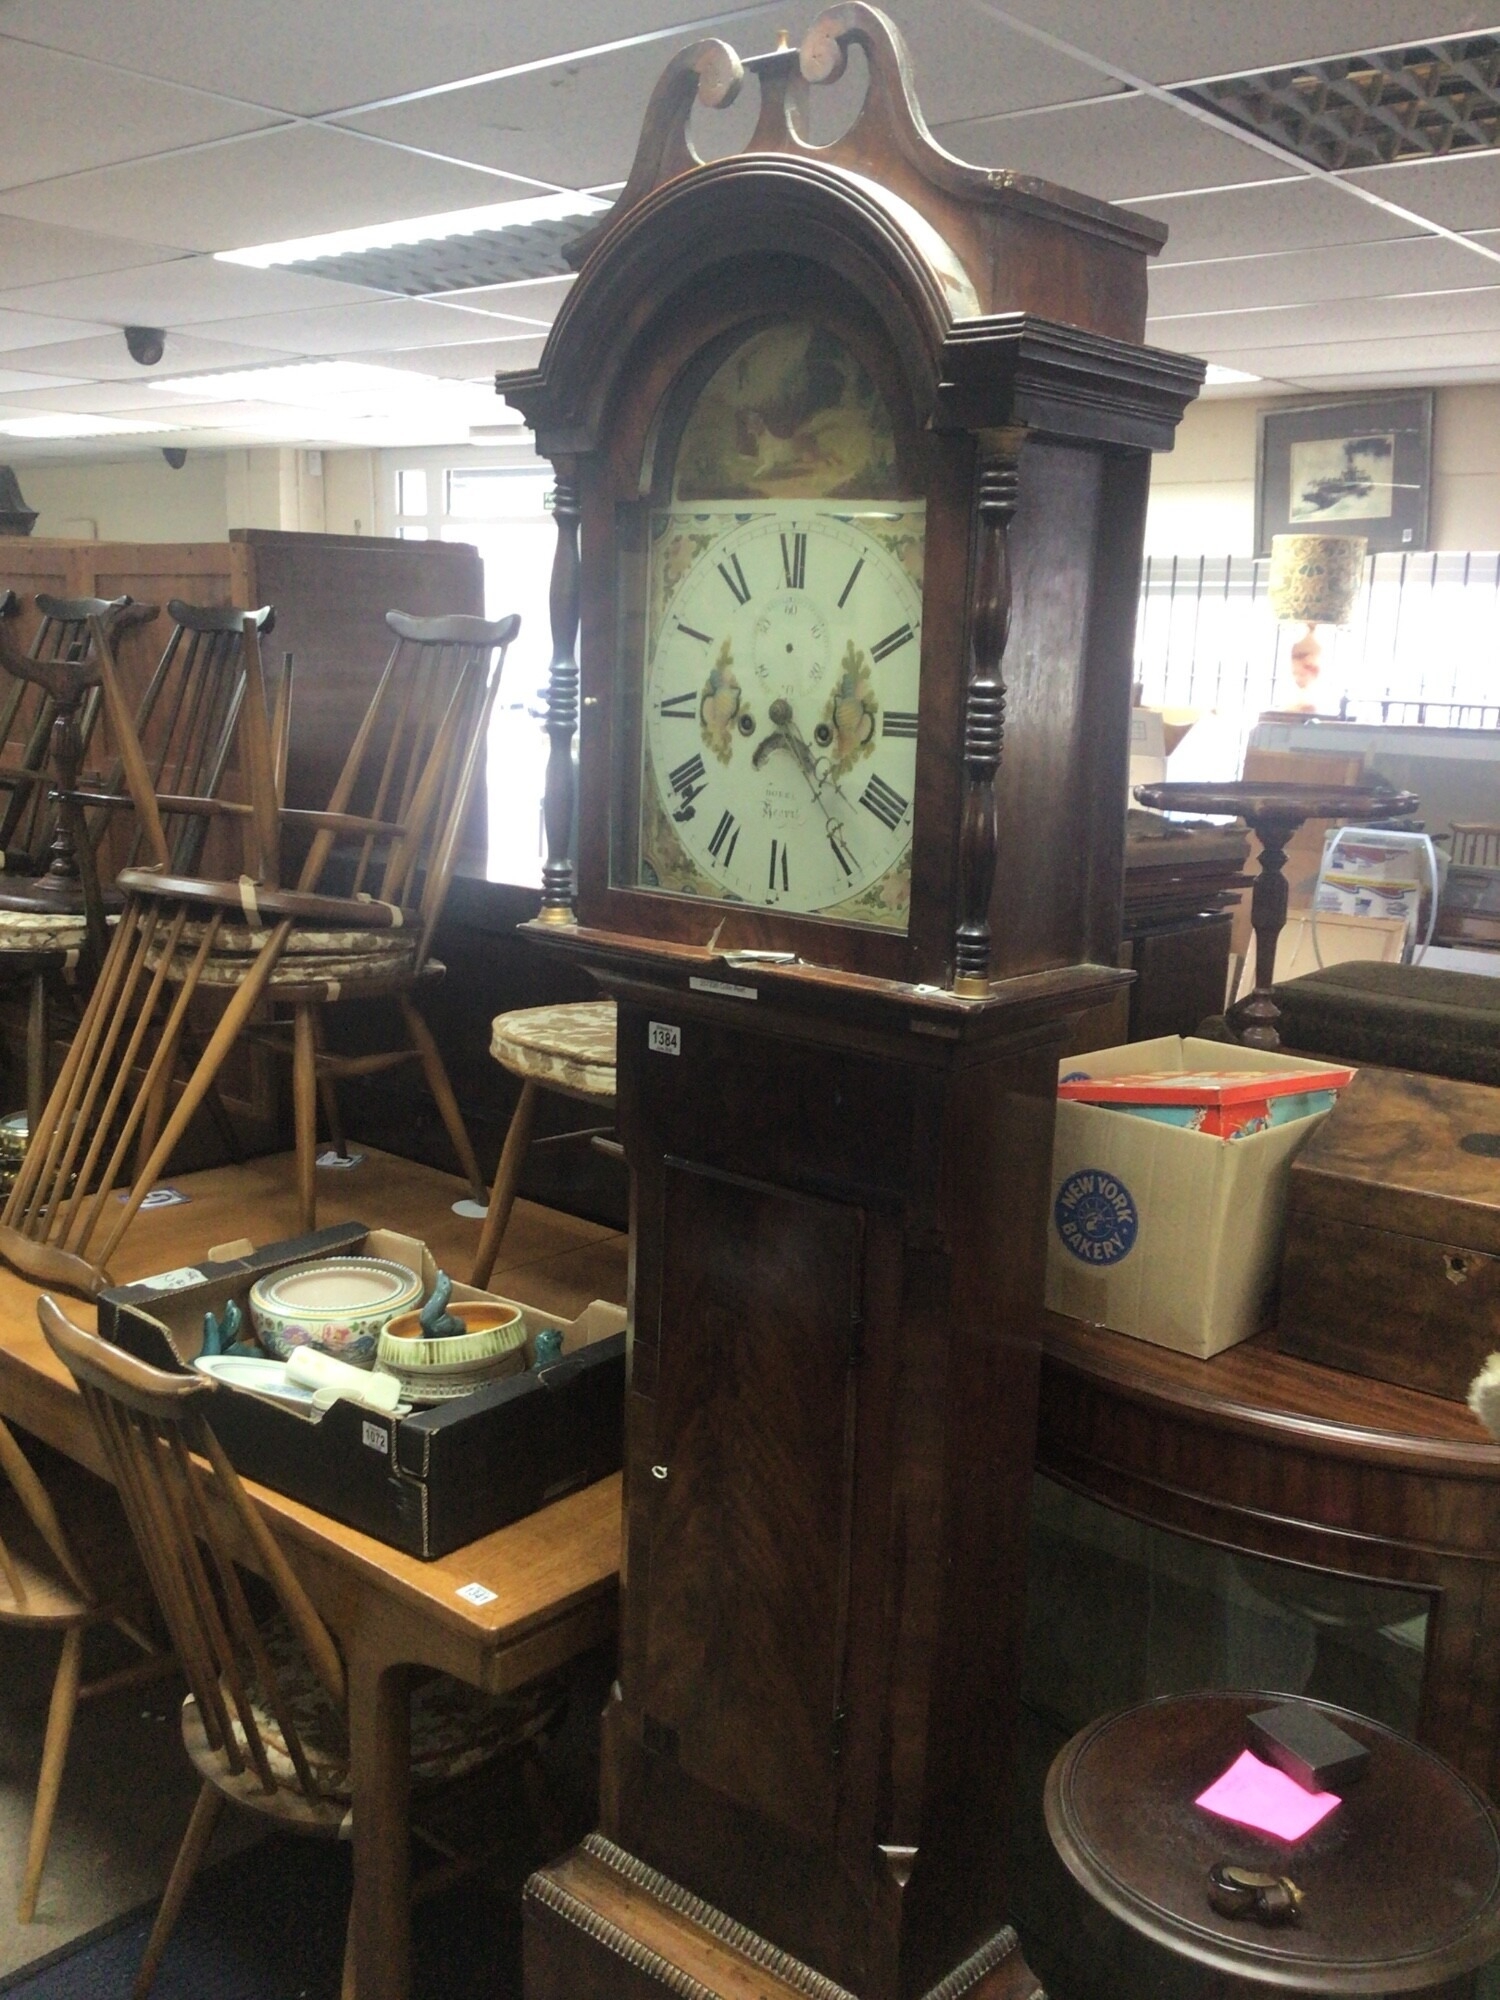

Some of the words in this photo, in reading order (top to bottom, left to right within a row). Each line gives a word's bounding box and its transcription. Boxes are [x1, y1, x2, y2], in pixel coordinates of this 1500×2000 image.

[652, 1029, 678, 1049] 1384
[1061, 1175, 1095, 1211] NEW
[1097, 1175, 1134, 1224] YORK
[1061, 1222, 1125, 1260] BAKERY
[365, 1428, 386, 1448] 1072
